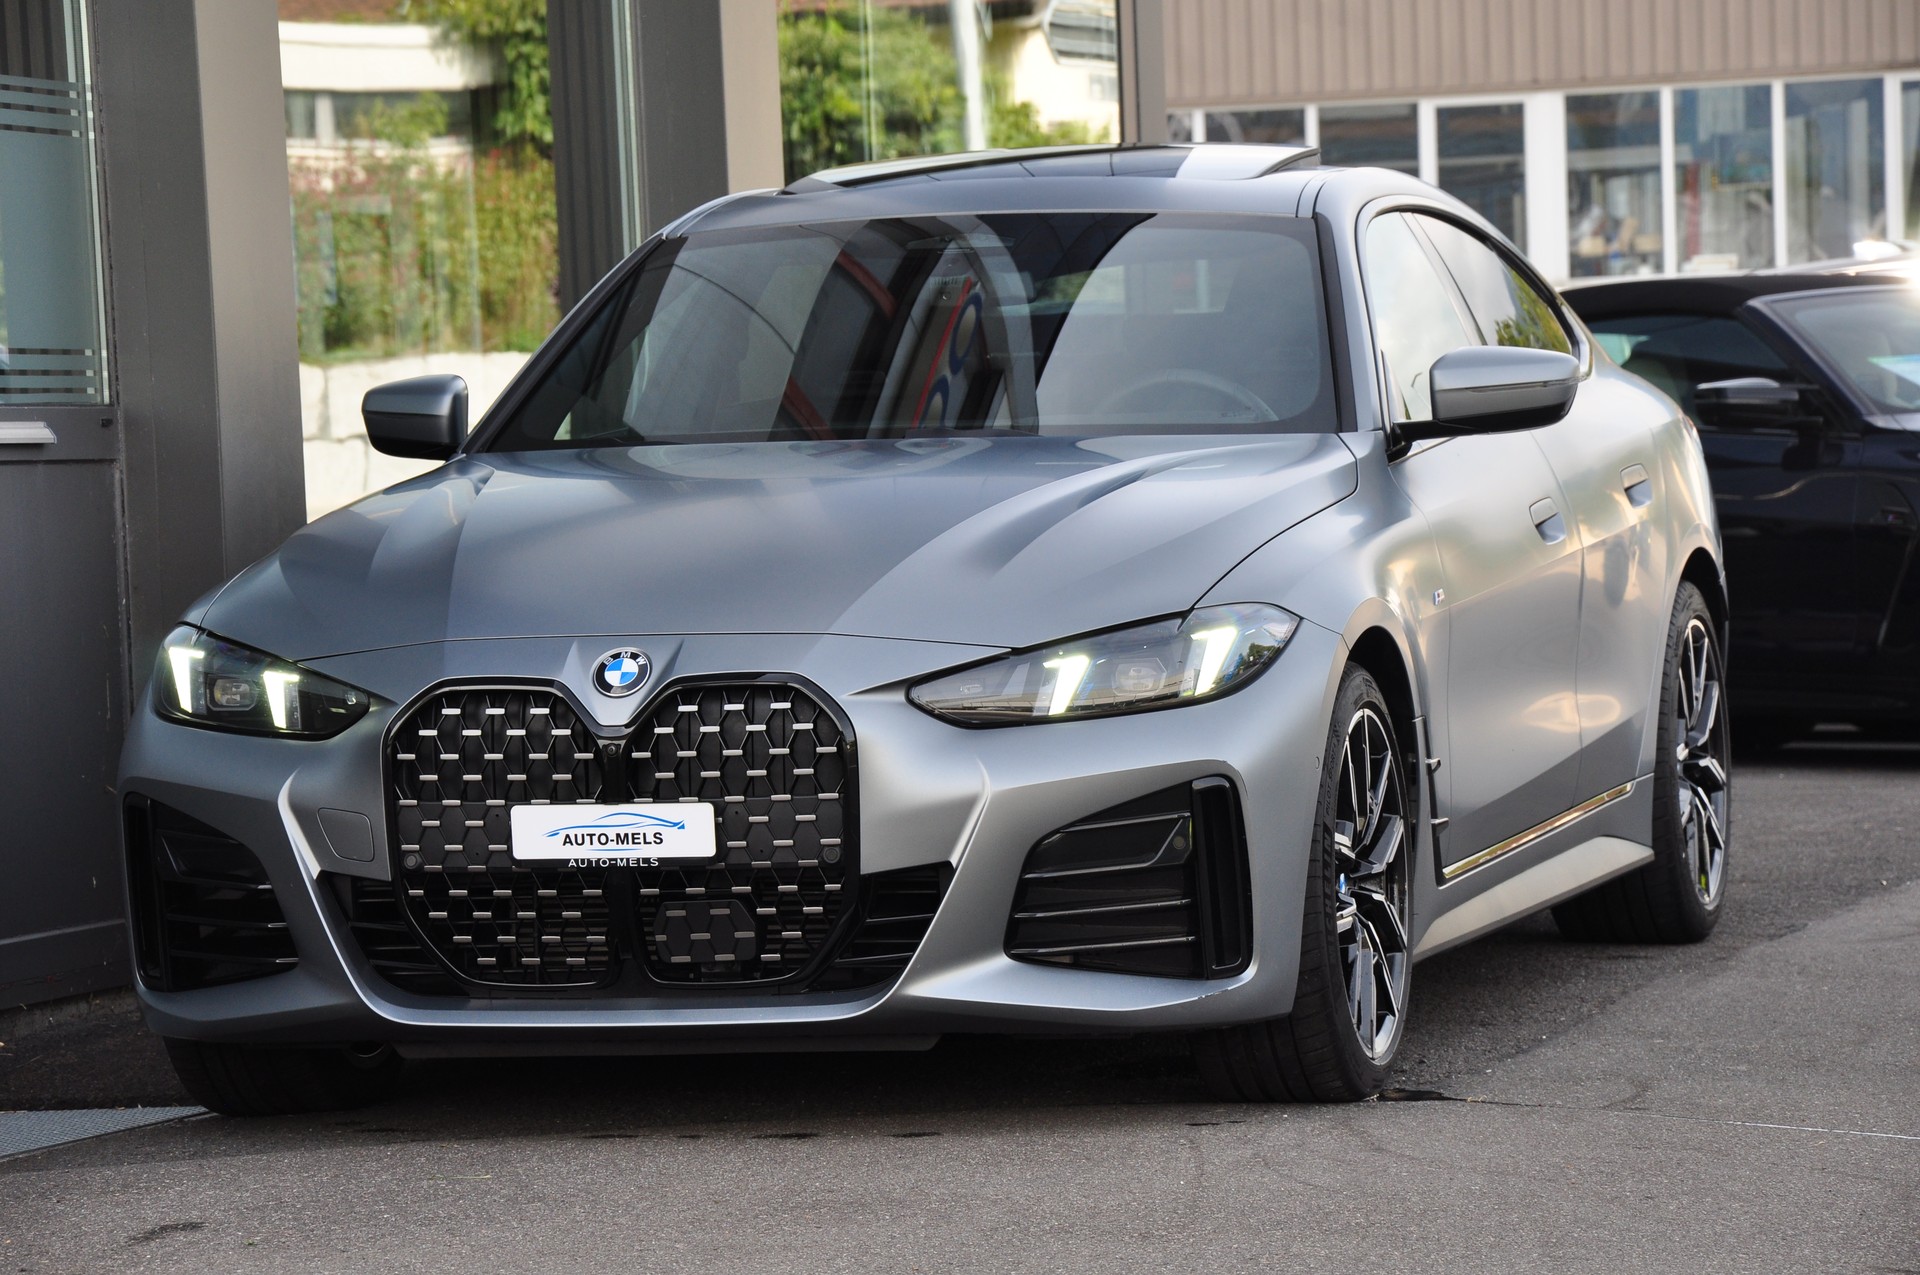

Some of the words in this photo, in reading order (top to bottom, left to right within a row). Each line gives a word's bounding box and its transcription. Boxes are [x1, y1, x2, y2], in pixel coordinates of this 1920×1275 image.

[603, 651, 647, 666] BMW
[562, 831, 664, 847] AUTO-MELS
[567, 856, 660, 868] AUTO-MELS
[1323, 832, 1337, 965] MICHELIN
